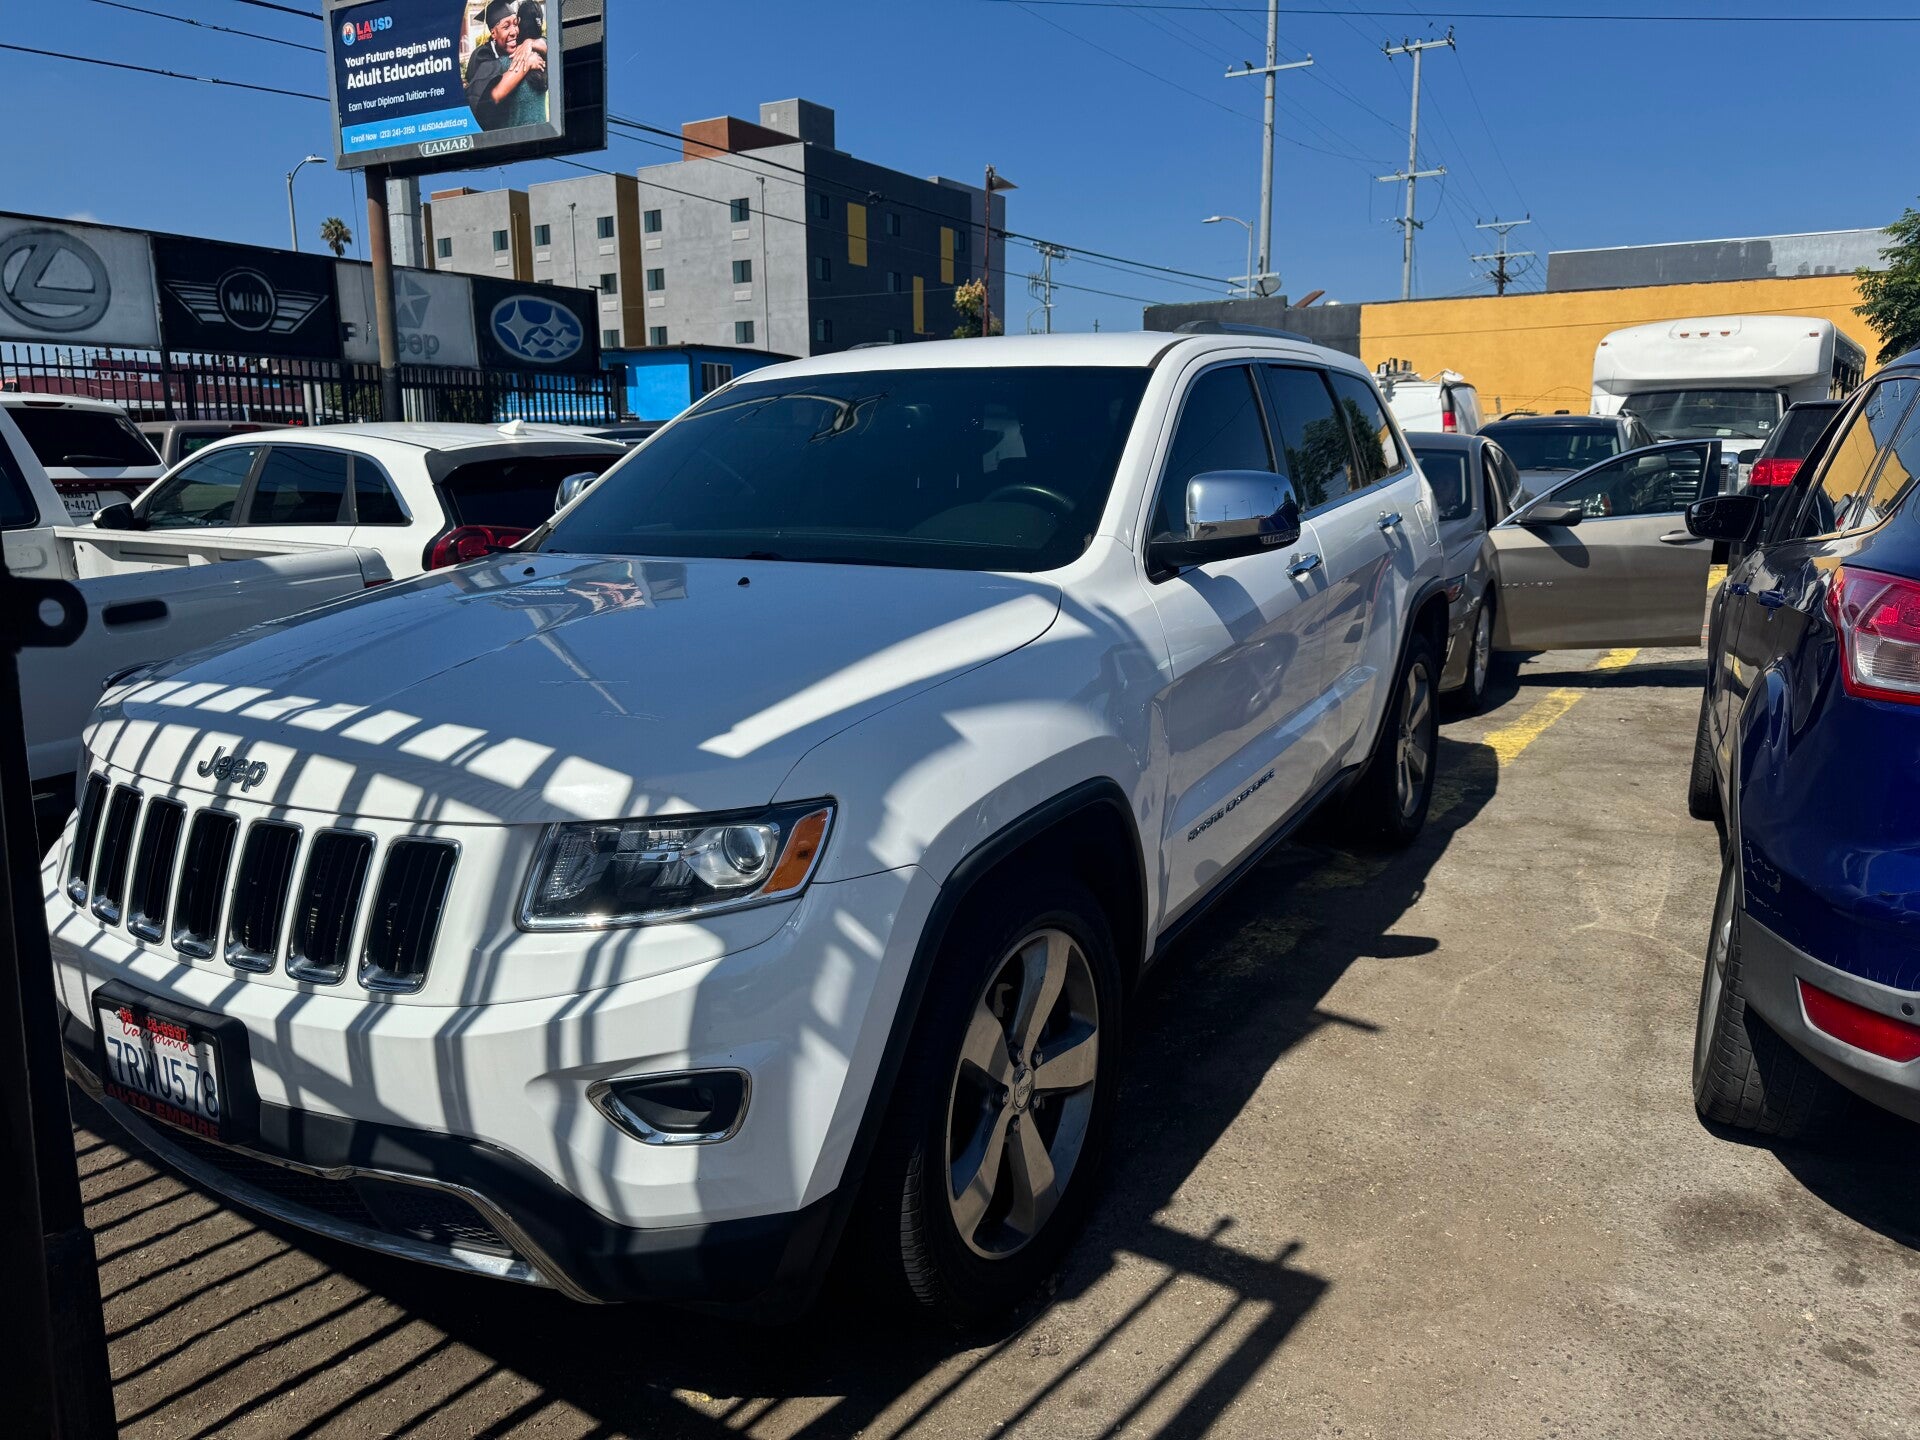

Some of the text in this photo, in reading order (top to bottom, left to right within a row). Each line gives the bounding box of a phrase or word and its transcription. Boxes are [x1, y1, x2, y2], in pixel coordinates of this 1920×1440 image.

[356, 16, 393, 35] LAUSD
[345, 37, 451, 68] Your Future Begins With
[347, 55, 452, 89] Adult Education
[348, 87, 445, 112] Earn Your Diploma Tuition-Free
[351, 134, 365, 143] Enroll
[425, 138, 468, 154] LAMAR
[229, 291, 269, 312] MINI
[398, 332, 439, 359] eep
[64, 500, 98, 512] R-4421
[197, 746, 268, 793] Jeep
[155, 1102, 220, 1139] EMPIRE
